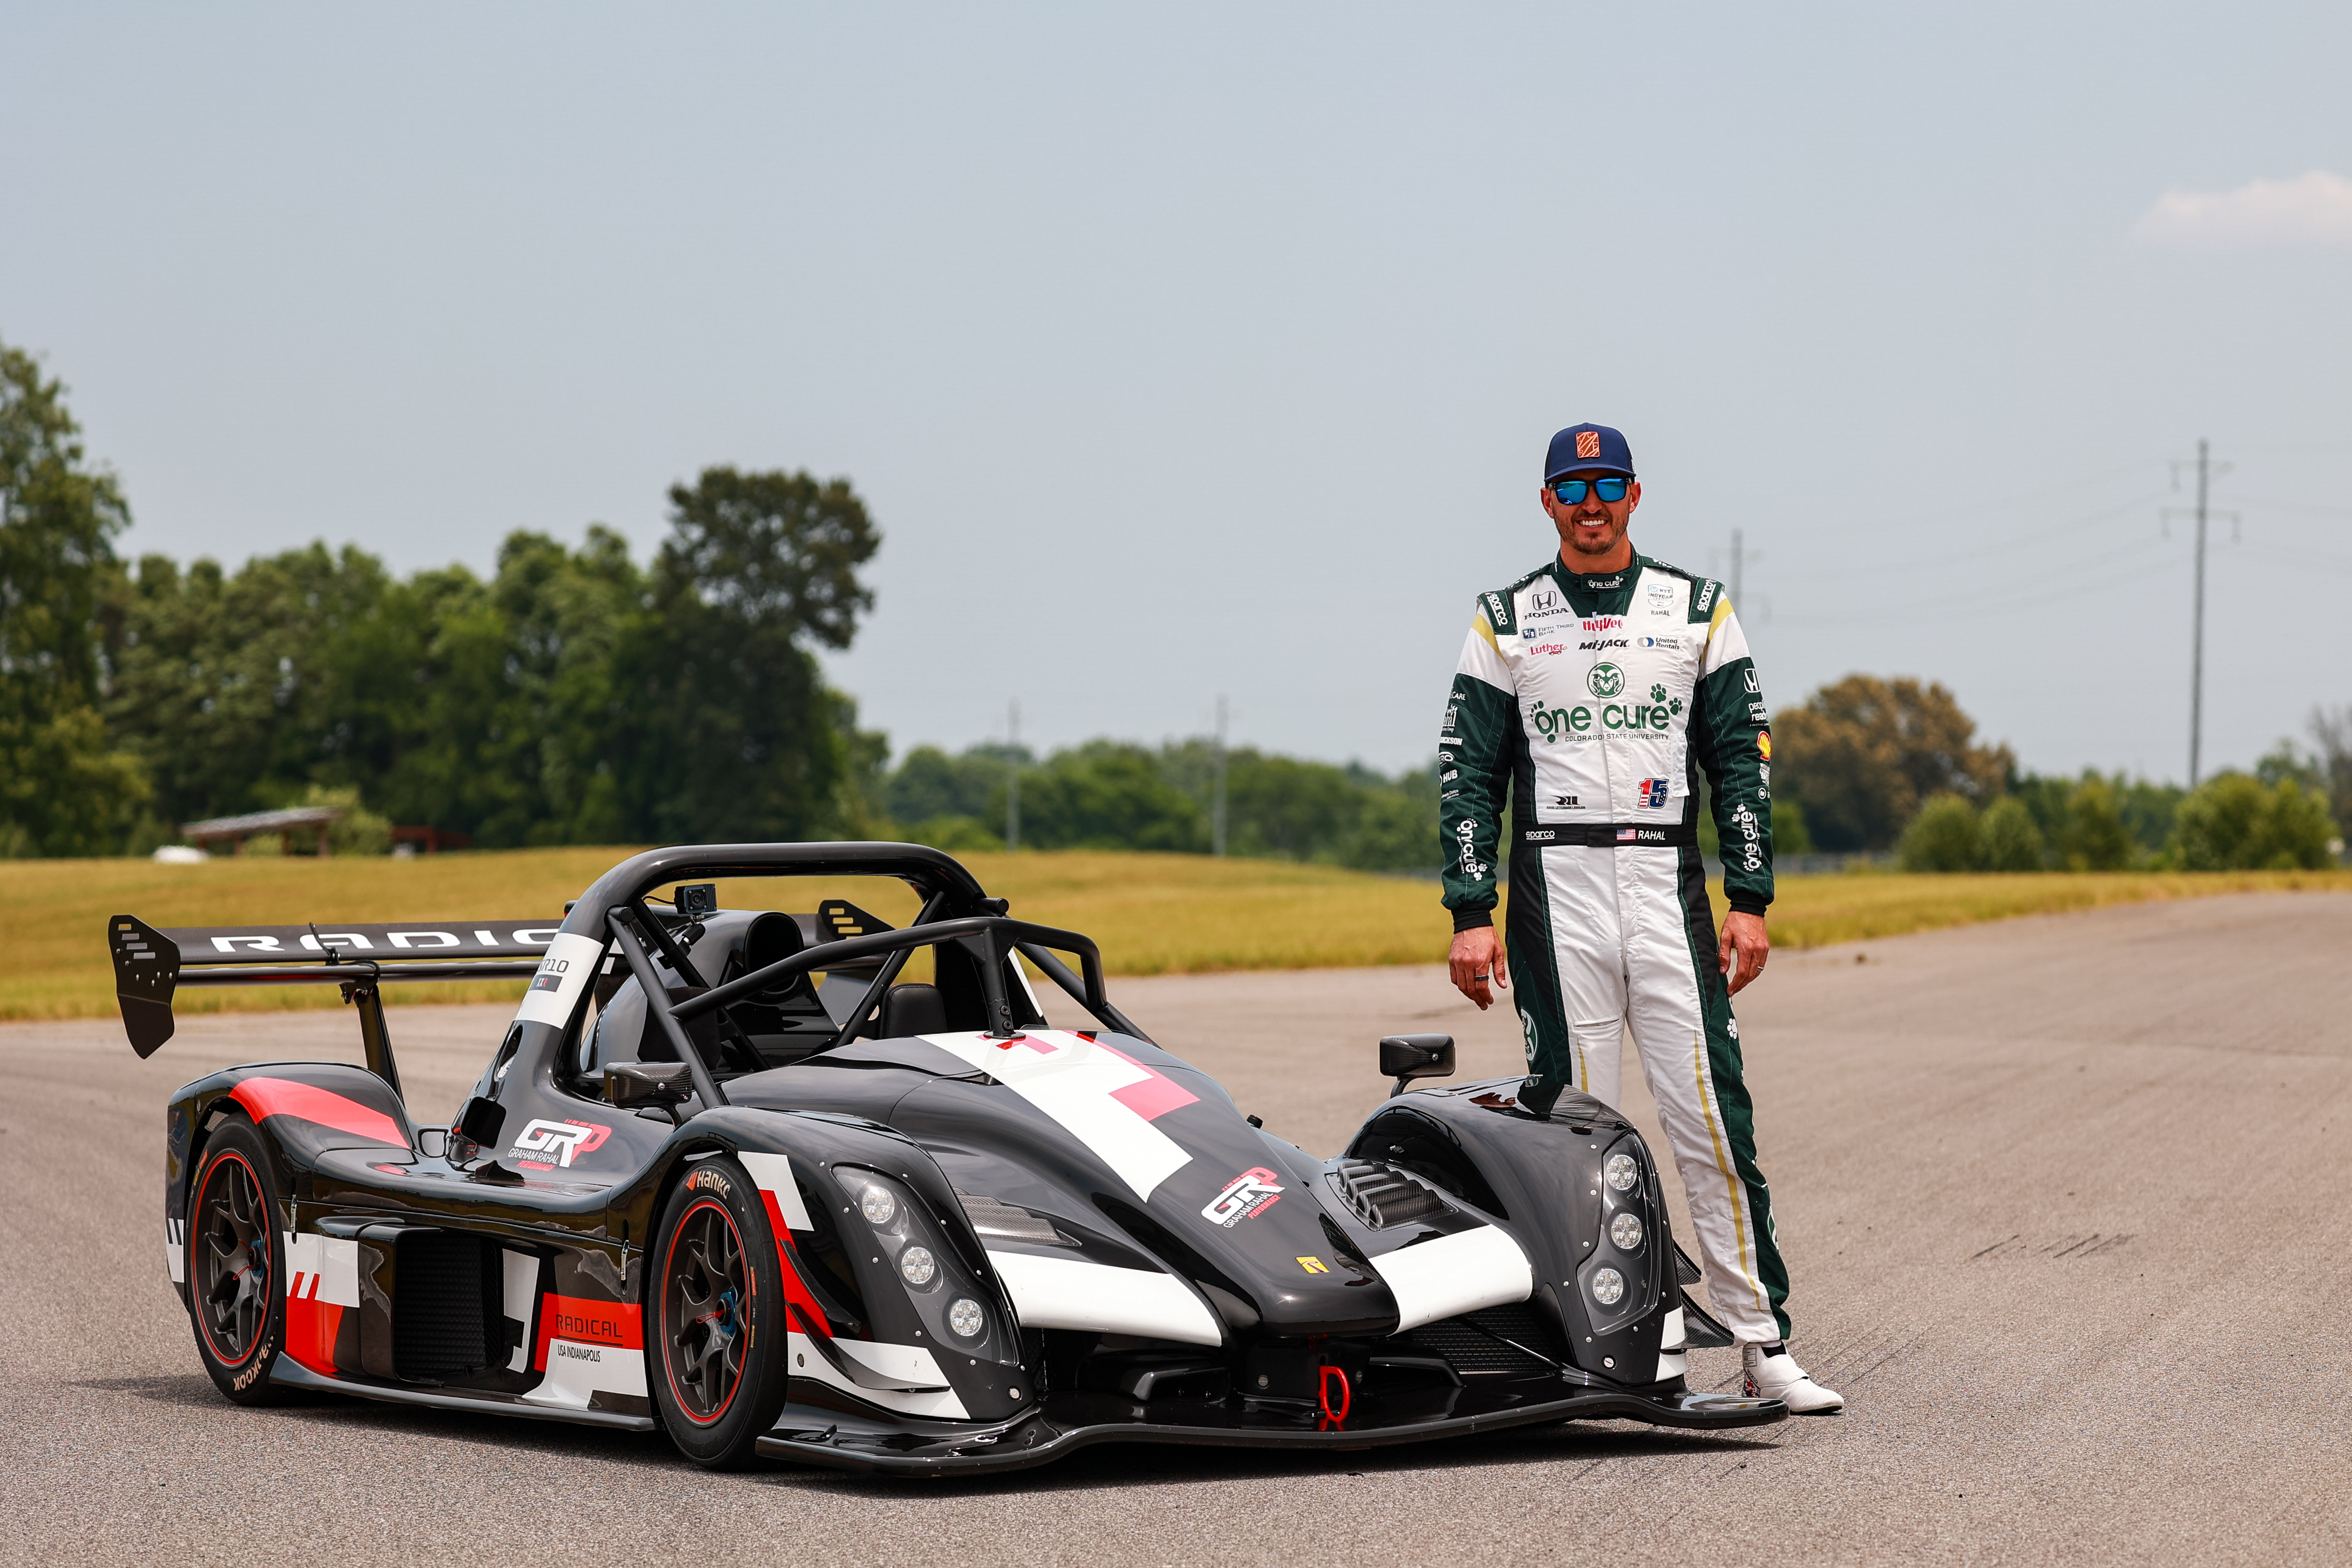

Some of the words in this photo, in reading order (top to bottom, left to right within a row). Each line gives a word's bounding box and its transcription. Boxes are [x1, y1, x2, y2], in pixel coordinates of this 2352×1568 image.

[1697, 582, 1716, 612] sparco
[1487, 593, 1508, 626] sparco
[1524, 608, 1569, 620] HONDA
[1530, 643, 1563, 656] Luther
[1578, 639, 1629, 651] MI-JACK
[1450, 691, 1466, 701] CARE
[1748, 699, 1765, 714] peopl
[1534, 706, 1592, 734] one
[1602, 704, 1669, 730] cure
[1565, 734, 1603, 742] COLORADO
[1443, 769, 1458, 783] HUB
[1637, 778, 1669, 808] 15
[1525, 830, 1555, 840] sparco
[1637, 830, 1666, 840] RAHAL
[1741, 811, 1757, 840] cure
[1463, 843, 1478, 873] cure
[1745, 843, 1760, 869] one
[210, 928, 560, 953] RADIC
[508, 1148, 539, 1161] GRAHAM
[536, 1152, 560, 1165] RAHAL
[1223, 1204, 1251, 1228] GRAHAM
[1250, 1192, 1274, 1211] RAHAL
[1248, 1194, 1281, 1219] PERFORMANCE
[556, 1314, 623, 1338] RADICAL
[558, 1344, 566, 1357] USA
[567, 1346, 600, 1363] INDIANAPOLIS
